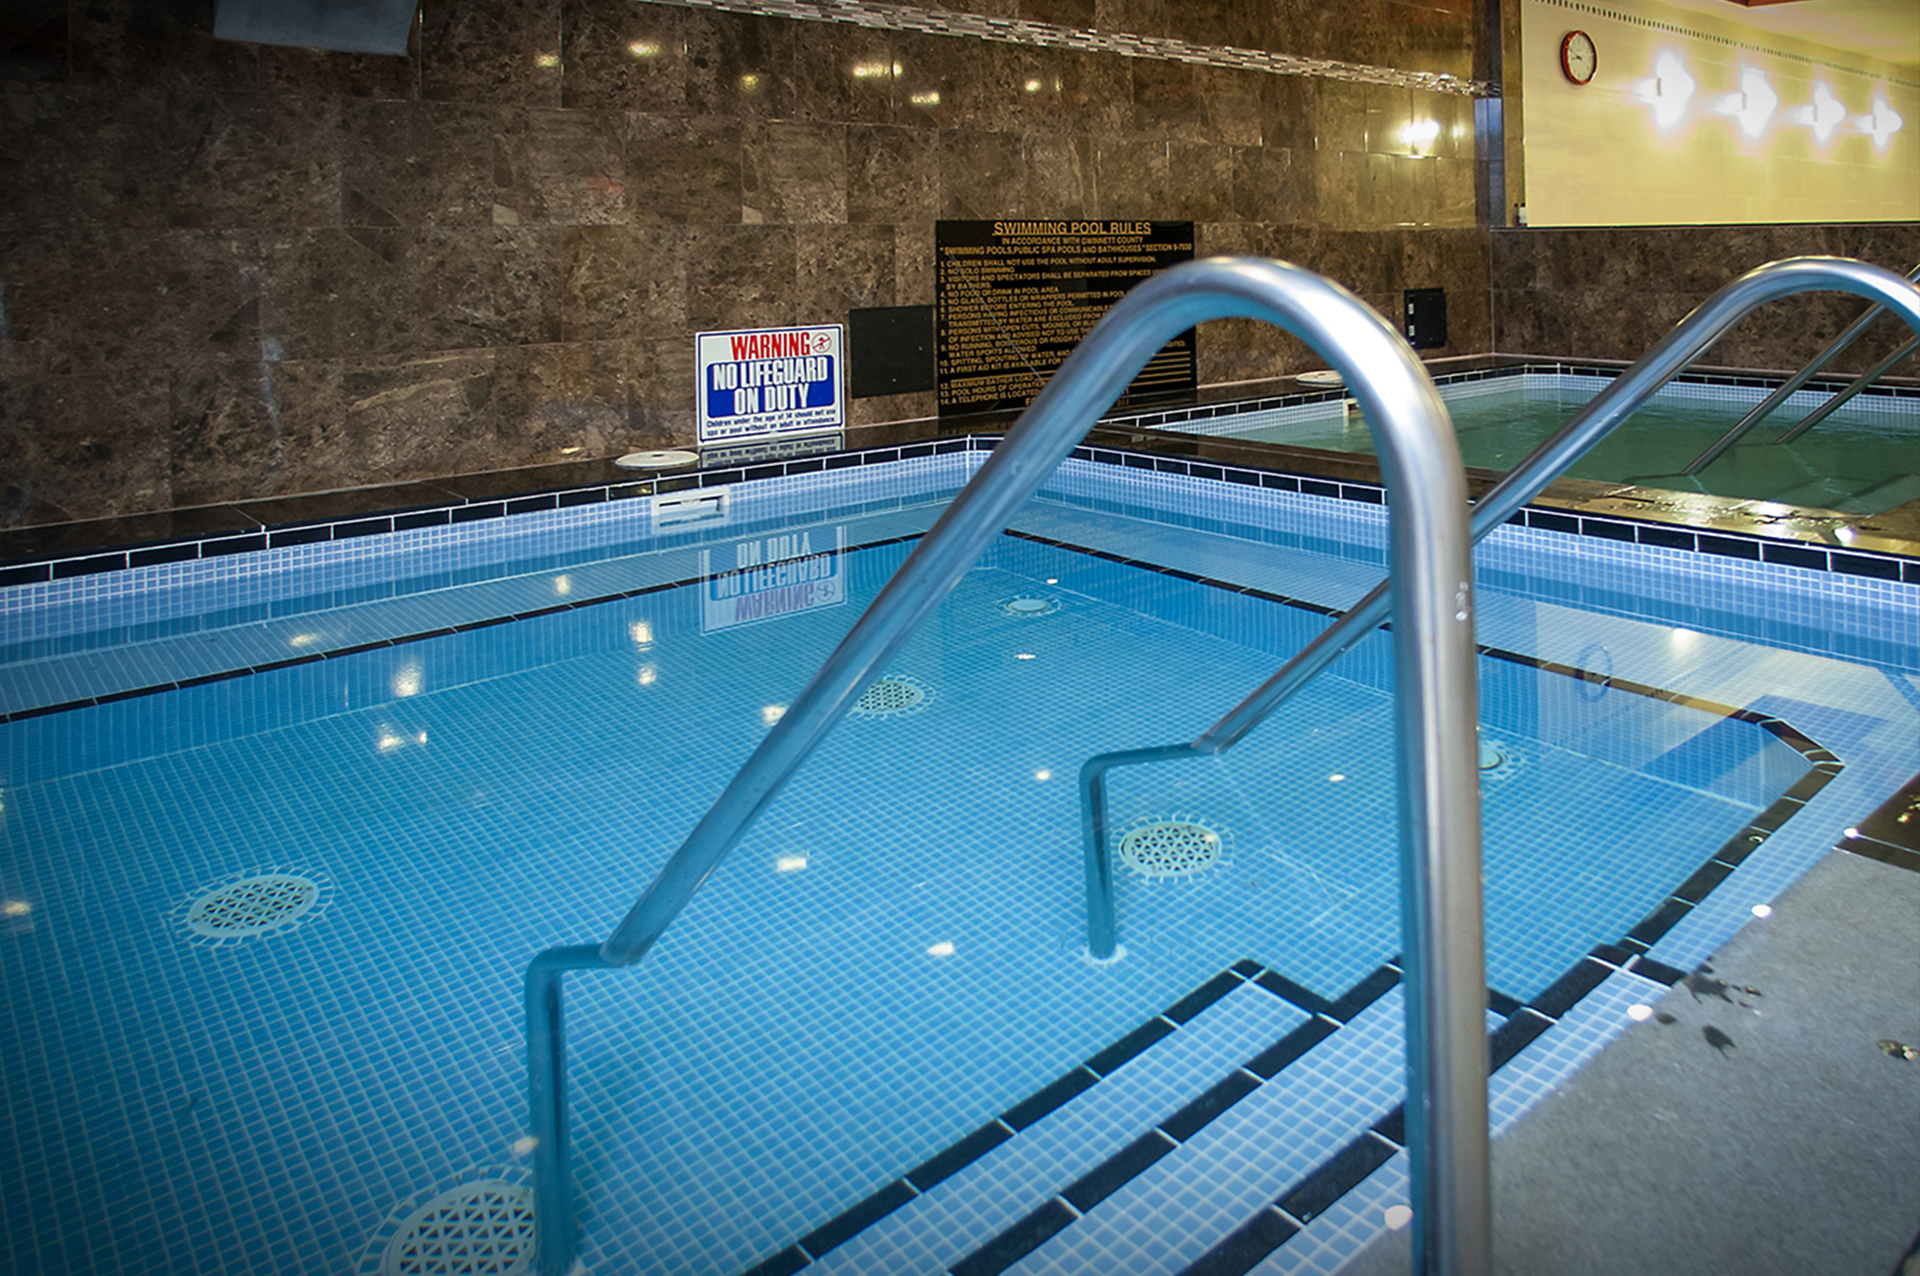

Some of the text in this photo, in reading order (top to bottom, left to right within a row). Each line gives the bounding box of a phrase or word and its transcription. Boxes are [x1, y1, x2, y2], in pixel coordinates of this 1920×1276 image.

[994, 220, 1152, 236] SWIMMING POOL RULES
[1002, 235, 1144, 245] IN ACCORDANCE WITH GWINNETT COUNTY
[1042, 246, 1056, 254] SPA
[1057, 245, 1080, 254] POOLS
[1082, 245, 1097, 253] AND
[940, 260, 946, 268] 1.
[946, 260, 982, 268] CHILDREN
[983, 259, 1005, 267] SHALL
[1022, 258, 1035, 266] USE
[1050, 257, 1068, 265] POOL
[1069, 256, 1096, 264] WITHOUT
[1097, 256, 1116, 264] ADULT
[960, 267, 980, 275] SOLO
[981, 266, 1015, 274] SWIMMING
[997, 272, 1040, 281] SPECTATORS
[1041, 272, 1062, 280] SHALL
[1063, 271, 1072, 279] BE
[1073, 270, 1110, 279] SEPARATED
[1129, 269, 1151, 277] SPACES
[960, 289, 980, 297] FOOD
[982, 288, 992, 296] OR
[993, 288, 1012, 296] DRINK
[1013, 287, 1020, 295] IN
[1022, 287, 1040, 295] POOL
[1041, 286, 1059, 294] AREA
[987, 295, 1018, 303] BOTTLES
[1019, 294, 1029, 302] OR
[1030, 293, 1066, 301] WRAPPERS
[1067, 291, 1101, 300] PERMITTED
[1102, 290, 1109, 298] IN
[948, 304, 979, 312] SHOWER
[980, 303, 1007, 311] BEFORE
[1009, 302, 1042, 310] ENTERING
[948, 312, 982, 321] PERSONS
[1009, 309, 1048, 318] INFECTIOUS
[1048, 308, 1058, 316] OR
[1008, 316, 1033, 325] WATER
[1048, 313, 1082, 322] EXCLUDED
[1083, 312, 1101, 320] FROM
[948, 327, 982, 336] PERSONS
[1001, 324, 1020, 332] OPEN
[1072, 320, 1082, 328] OR
[948, 335, 958, 343] OF
[960, 333, 996, 342] INFECTION
[1012, 330, 1041, 338] ADVISED
[1041, 329, 1055, 337] NOT
[1056, 328, 1065, 336] TO
[1066, 327, 1079, 335] USE
[731, 332, 811, 361] WARNING
[948, 343, 960, 351] NO
[1039, 337, 1049, 345] OR
[1050, 335, 1073, 344] ROUGH
[948, 349, 975, 358] WATER
[976, 347, 1003, 356] SPORTS
[985, 354, 1019, 363] SPOUTING
[713, 356, 829, 391] NO LIFEGUARD
[950, 366, 956, 374] A
[957, 365, 977, 373] FIRST
[978, 363, 990, 372] AID
[991, 362, 1002, 370] KIT
[1003, 361, 1010, 369] IS
[951, 388, 971, 397] POOL
[972, 385, 996, 395] HOURS
[998, 384, 1007, 393] OF
[734, 382, 810, 416] ON DUTY
[951, 397, 958, 405] A
[959, 394, 999, 404] TELEPHONE
[706, 418, 732, 428] Children
[734, 416, 750, 426] under
[752, 414, 763, 423] the
[765, 413, 776, 423] age
[778, 411, 785, 421] of
[794, 408, 813, 418] should
[815, 408, 825, 417] not
[706, 428, 718, 437] spa
[729, 424, 743, 435] pool
[745, 421, 768, 431] without
[779, 419, 794, 428] adult
[796, 418, 801, 426] in
